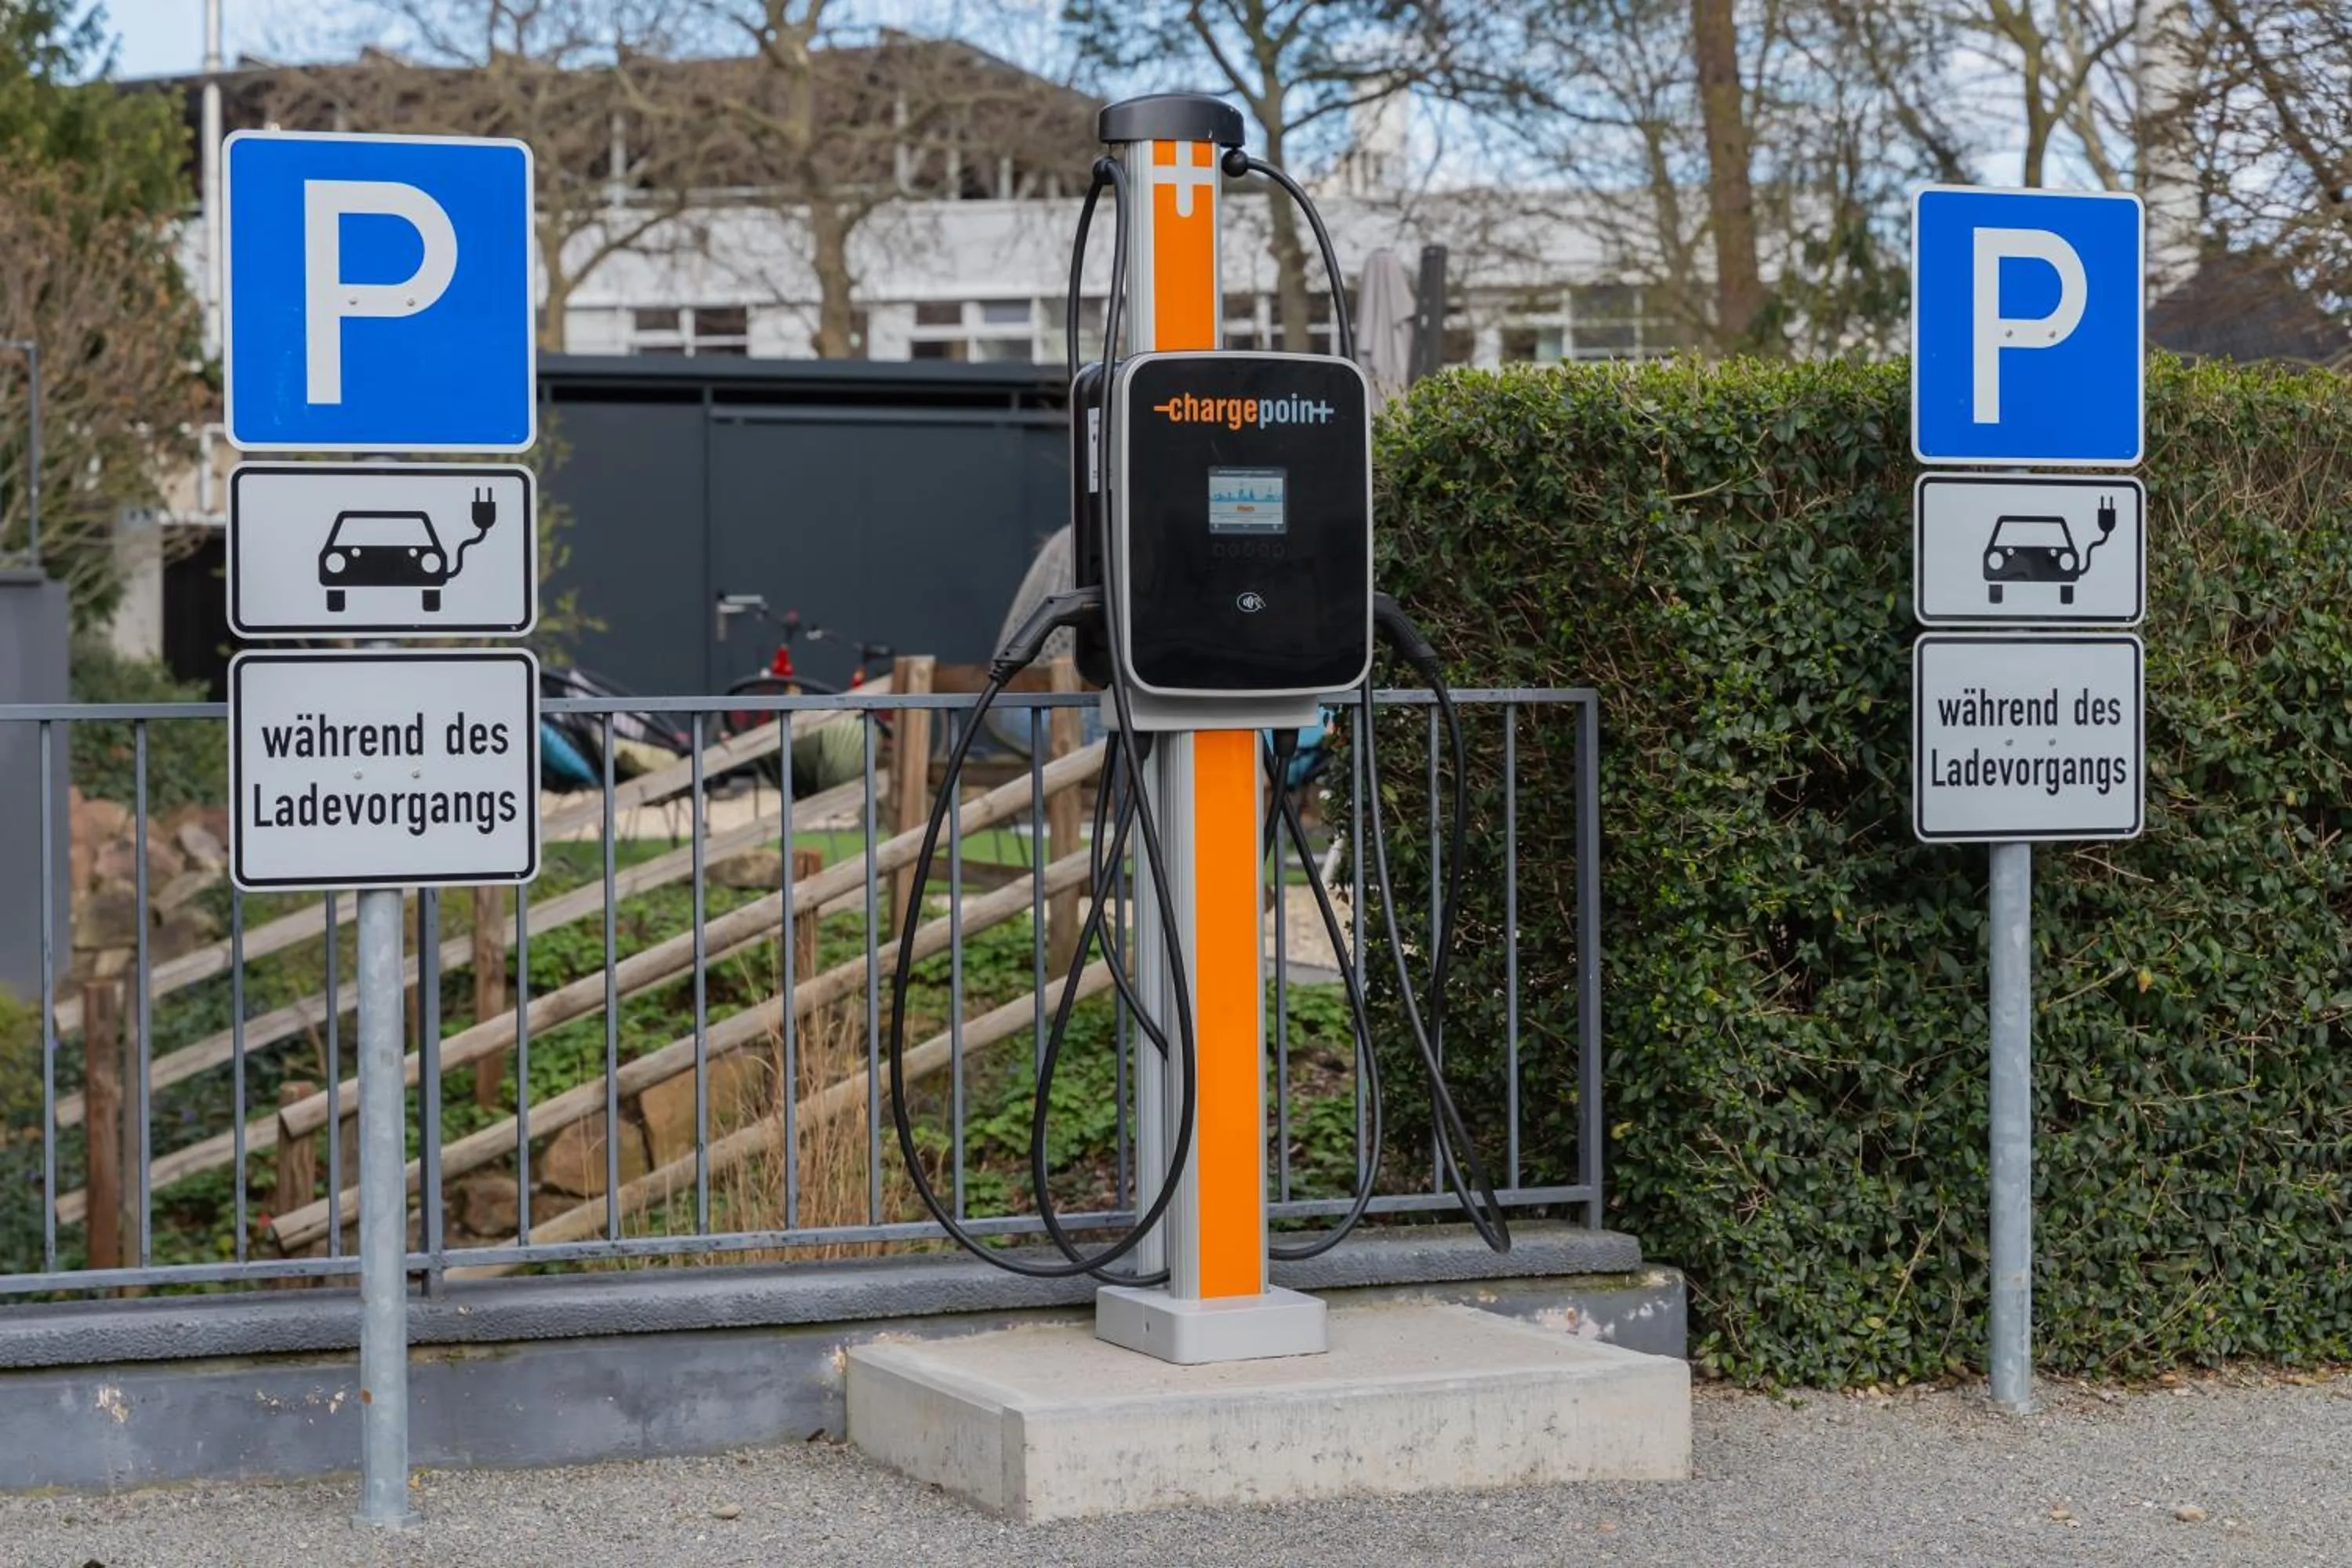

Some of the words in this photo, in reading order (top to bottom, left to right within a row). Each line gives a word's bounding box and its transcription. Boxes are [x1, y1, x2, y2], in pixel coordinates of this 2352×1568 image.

[304, 179, 458, 404] P
[1973, 227, 2087, 424] P
[1938, 688, 2058, 727] während
[2074, 688, 2121, 726] des
[261, 712, 424, 758] während
[445, 711, 510, 755] des
[1931, 748, 2127, 796] Ladevorgangs
[253, 782, 517, 837] Ladevorgangs
